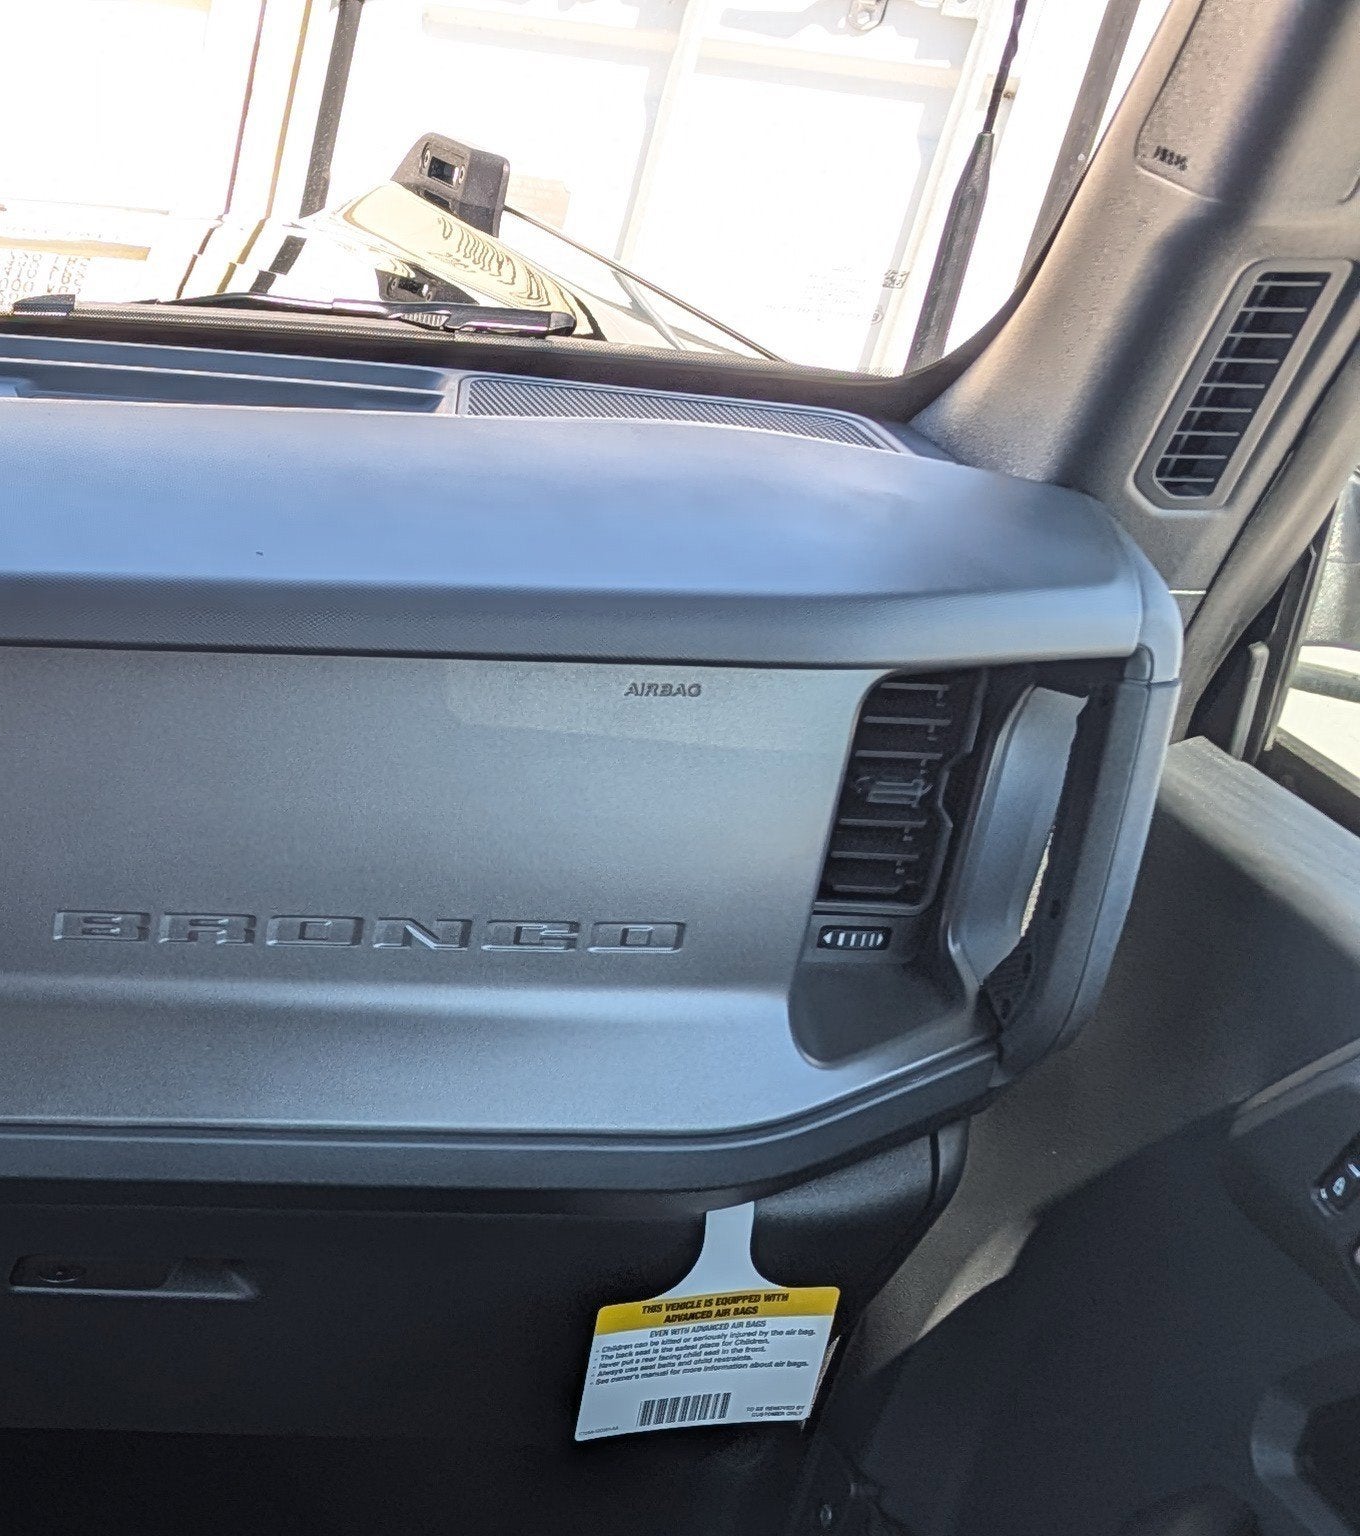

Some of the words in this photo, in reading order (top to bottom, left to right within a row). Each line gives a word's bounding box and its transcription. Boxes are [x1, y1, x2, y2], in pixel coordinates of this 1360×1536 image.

[624, 682, 702, 699] AIRBAG
[52, 908, 686, 955] BRONCO
[642, 1304, 663, 1314] THIS
[665, 1301, 702, 1312] VEHICLE
[704, 1300, 712, 1308] IS
[715, 1295, 761, 1307] EQUIPPED
[763, 1293, 789, 1303] WITH
[663, 1311, 712, 1323] ADVANCED
[714, 1308, 731, 1318] AIR
[733, 1306, 758, 1316] BAGS
[650, 1329, 668, 1338] EVEN
[670, 1327, 689, 1336] WITH
[691, 1324, 729, 1334] ADVANCED
[731, 1322, 744, 1330] AIR
[602, 1343, 633, 1353] Children
[661, 1337, 682, 1346] killed
[693, 1333, 728, 1343] seriously
[730, 1330, 754, 1340] injured
[756, 1330, 769, 1338] by
[797, 1328, 816, 1337] bag.
